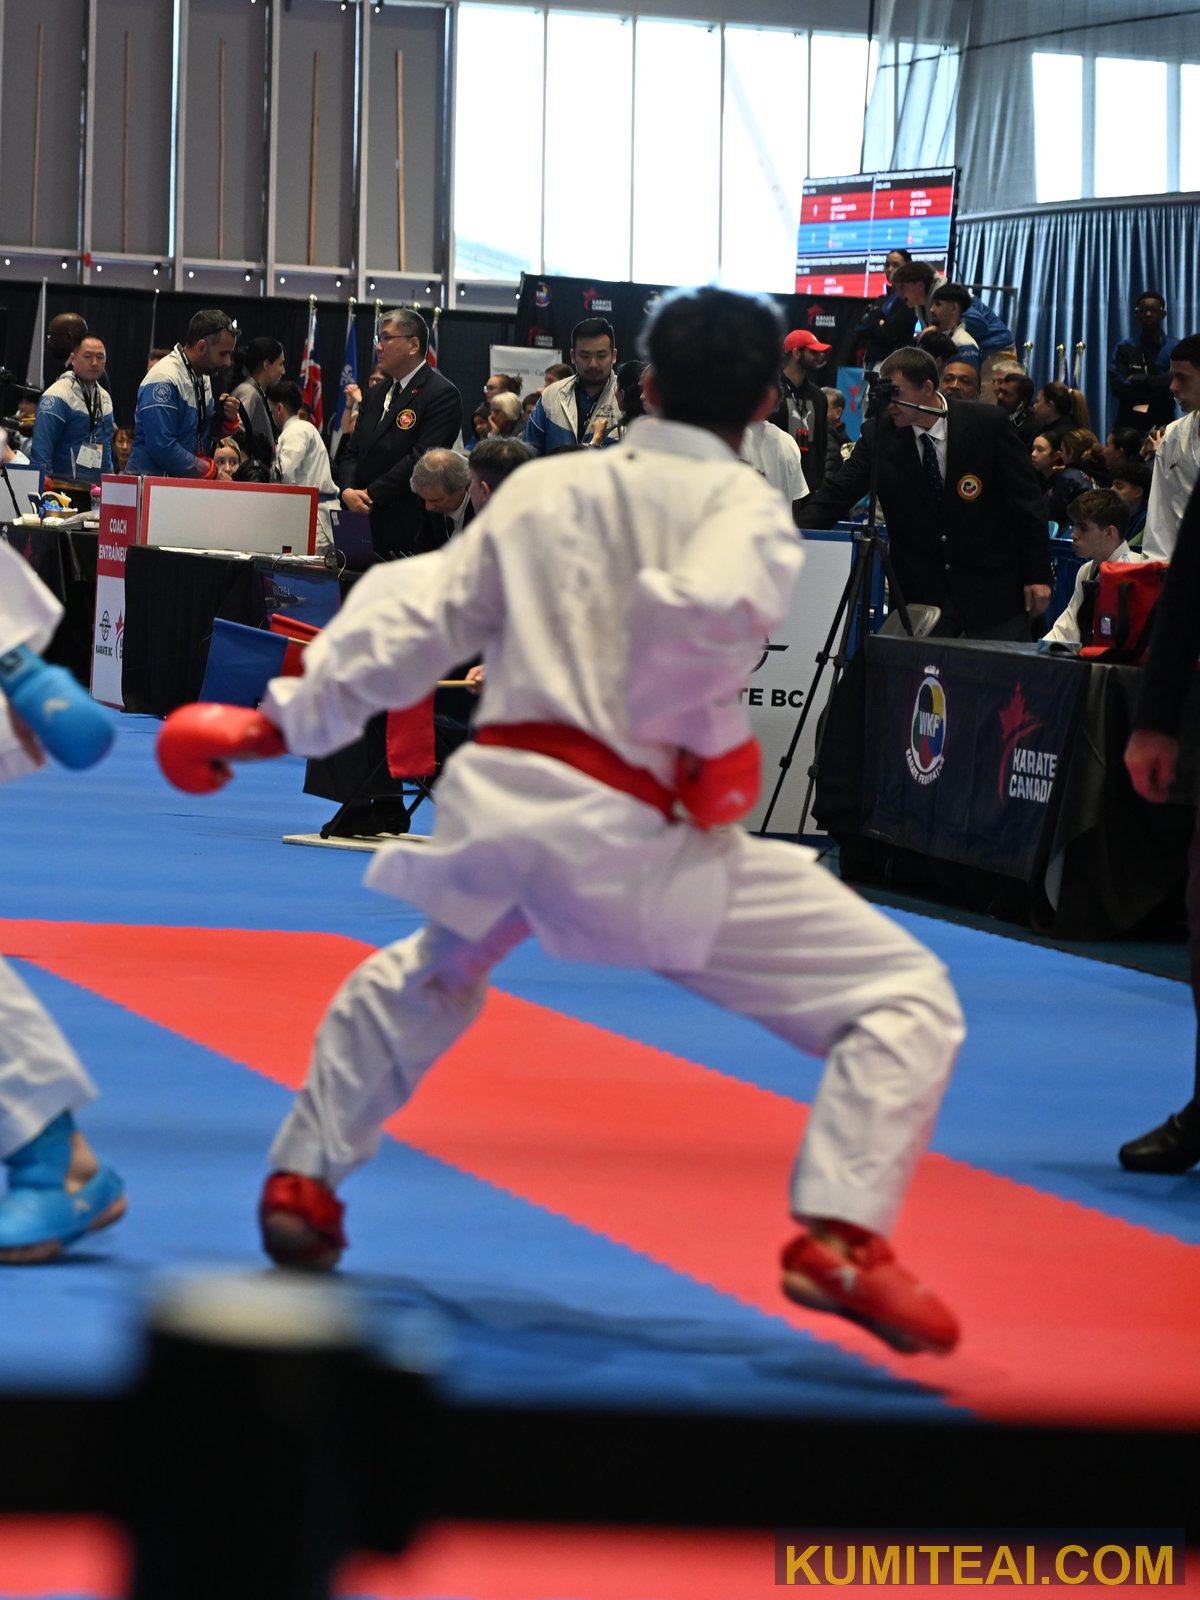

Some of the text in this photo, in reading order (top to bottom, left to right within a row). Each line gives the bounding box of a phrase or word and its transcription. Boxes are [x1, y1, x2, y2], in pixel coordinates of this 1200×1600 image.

[109, 518, 128, 534] COACH
[771, 689, 804, 708] BC
[919, 711, 940, 738] WKF
[1012, 748, 1058, 778] KARATE
